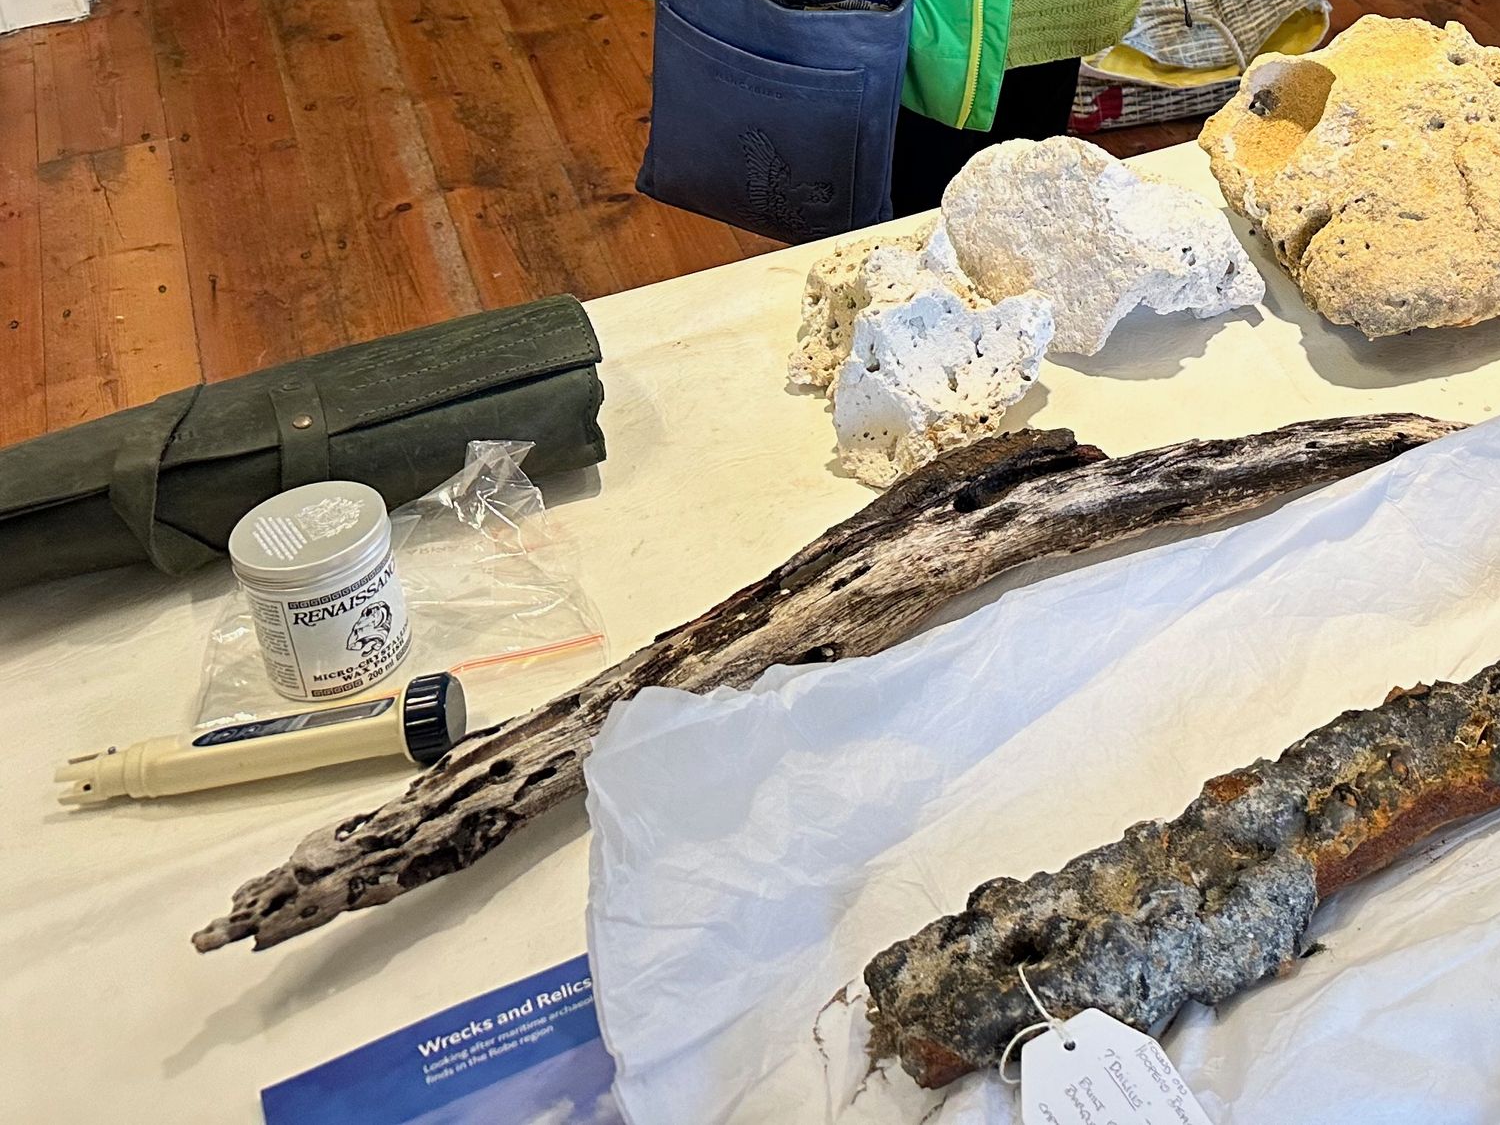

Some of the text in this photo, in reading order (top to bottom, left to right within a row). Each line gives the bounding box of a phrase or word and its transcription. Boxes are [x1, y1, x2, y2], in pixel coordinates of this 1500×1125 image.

[342, 636, 405, 682] WAX POLISH
[367, 658, 395, 681] 200 ml
[418, 976, 593, 1057] Wrecks and Relics
[422, 1048, 469, 1075] Looking
[469, 1036, 496, 1055] after
[455, 1060, 467, 1073] in
[467, 1052, 488, 1068] the
[488, 1039, 519, 1058] Robe
[518, 1024, 555, 1045] region
